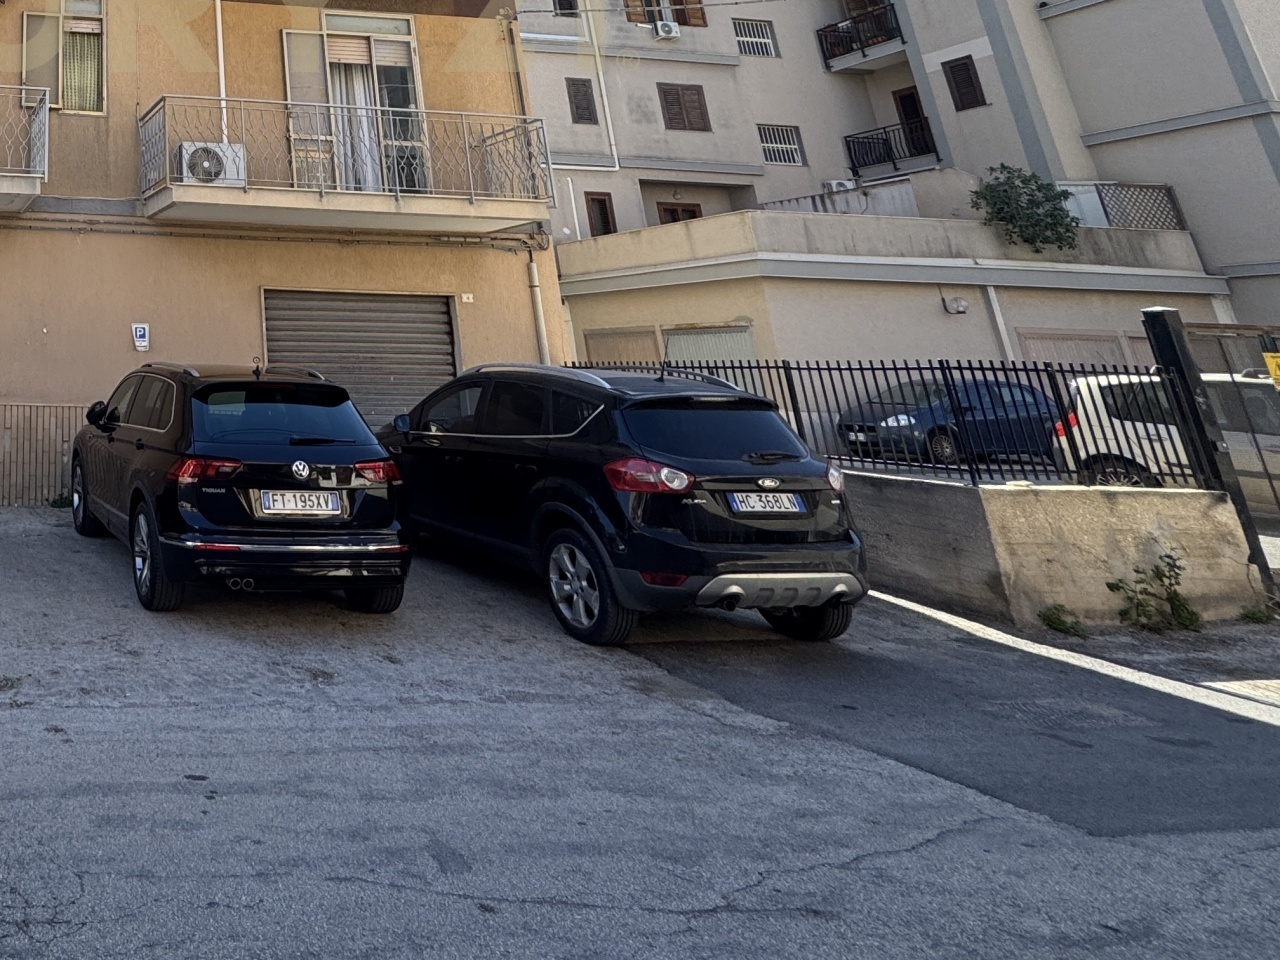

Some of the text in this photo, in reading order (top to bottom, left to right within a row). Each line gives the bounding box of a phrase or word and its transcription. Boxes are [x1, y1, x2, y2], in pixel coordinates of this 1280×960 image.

[136, 327, 145, 339] P
[271, 493, 330, 509] FT 195XV
[736, 493, 799, 510] HC 368LN
